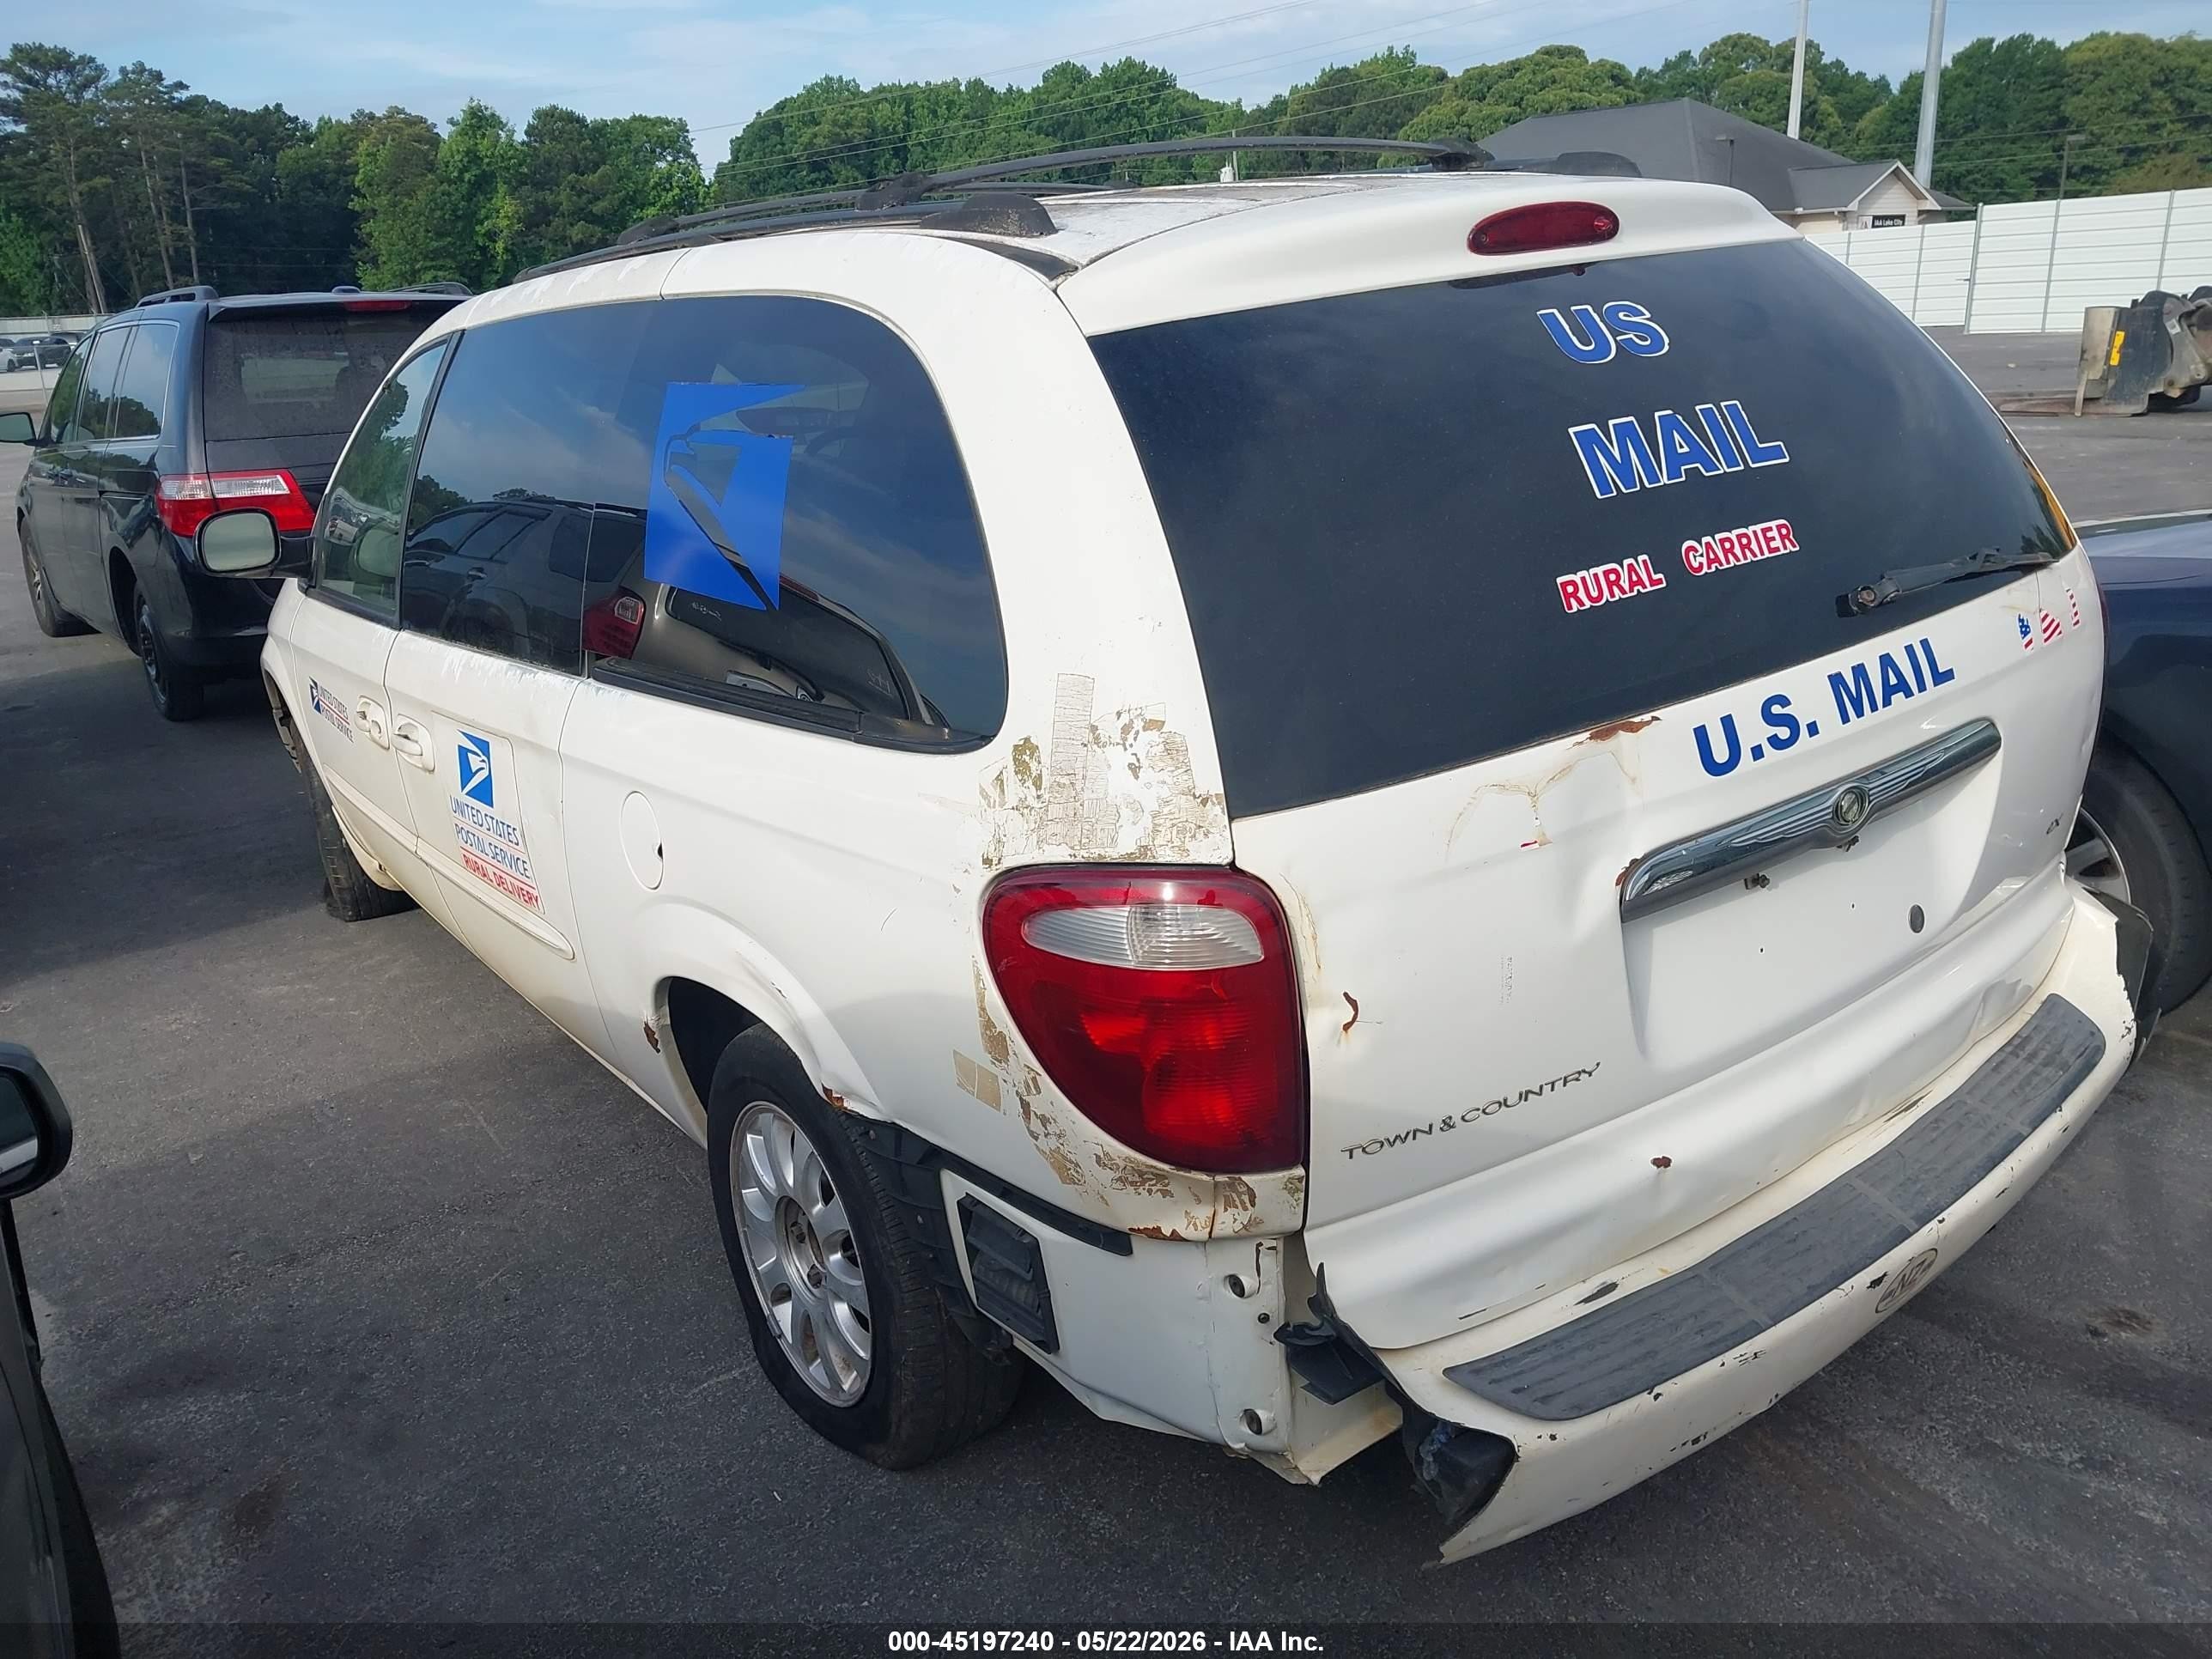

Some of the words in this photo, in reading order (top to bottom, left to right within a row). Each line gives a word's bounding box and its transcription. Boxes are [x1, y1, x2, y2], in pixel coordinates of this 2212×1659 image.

[1537, 301, 1669, 364] US
[1568, 400, 1790, 498] MAIL
[1557, 555, 1666, 612] RURAL
[1681, 519, 1799, 575] CARRIER
[1692, 694, 1820, 777] U.S.
[1827, 638, 1955, 725] MAIL
[450, 794, 483, 827] UNITED
[484, 812, 520, 847] STATES
[454, 823, 489, 857] POSTAL
[489, 842, 531, 879] SERVICE
[463, 854, 494, 884] RURAL
[493, 870, 540, 911] DELIVERY
[1340, 1122, 1433, 1159] TOWN
[1439, 1115, 1457, 1133] &
[1461, 1061, 1601, 1123] COUNTRY
